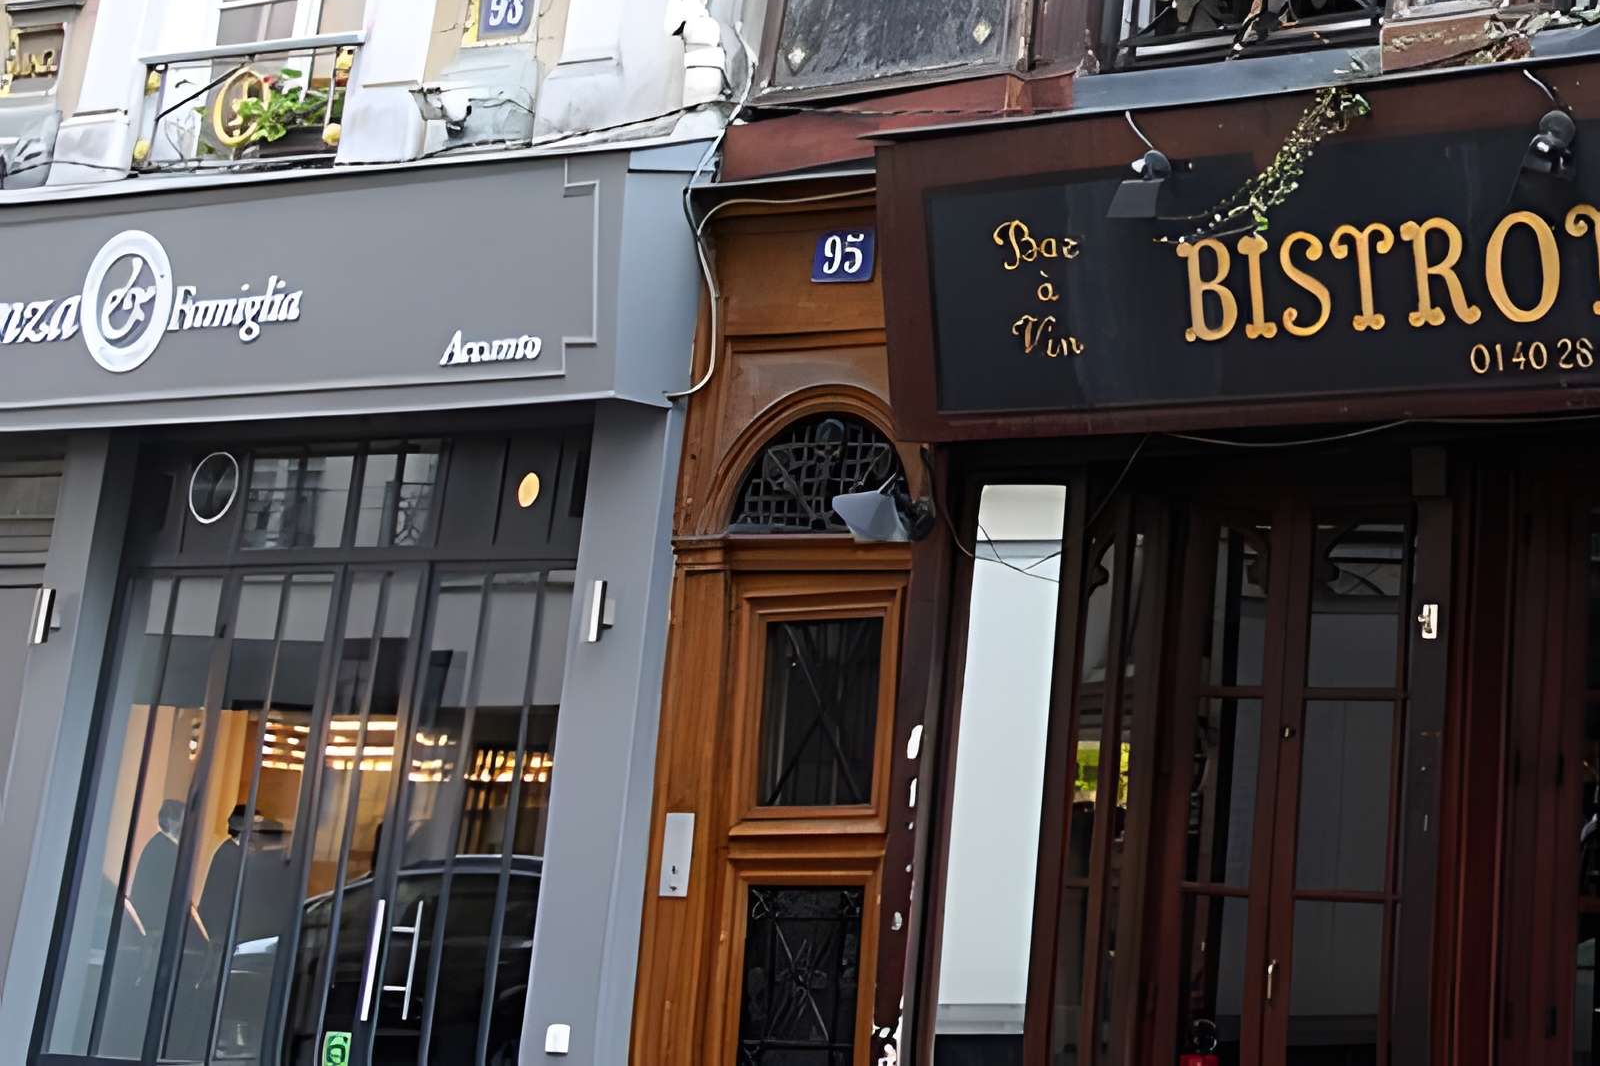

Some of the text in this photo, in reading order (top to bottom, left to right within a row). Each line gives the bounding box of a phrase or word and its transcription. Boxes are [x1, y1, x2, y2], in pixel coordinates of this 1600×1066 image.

[822, 233, 865, 274] 95
[993, 220, 1080, 270] Bar
[1037, 270, 1060, 302] à
[1012, 314, 1085, 358] Vin
